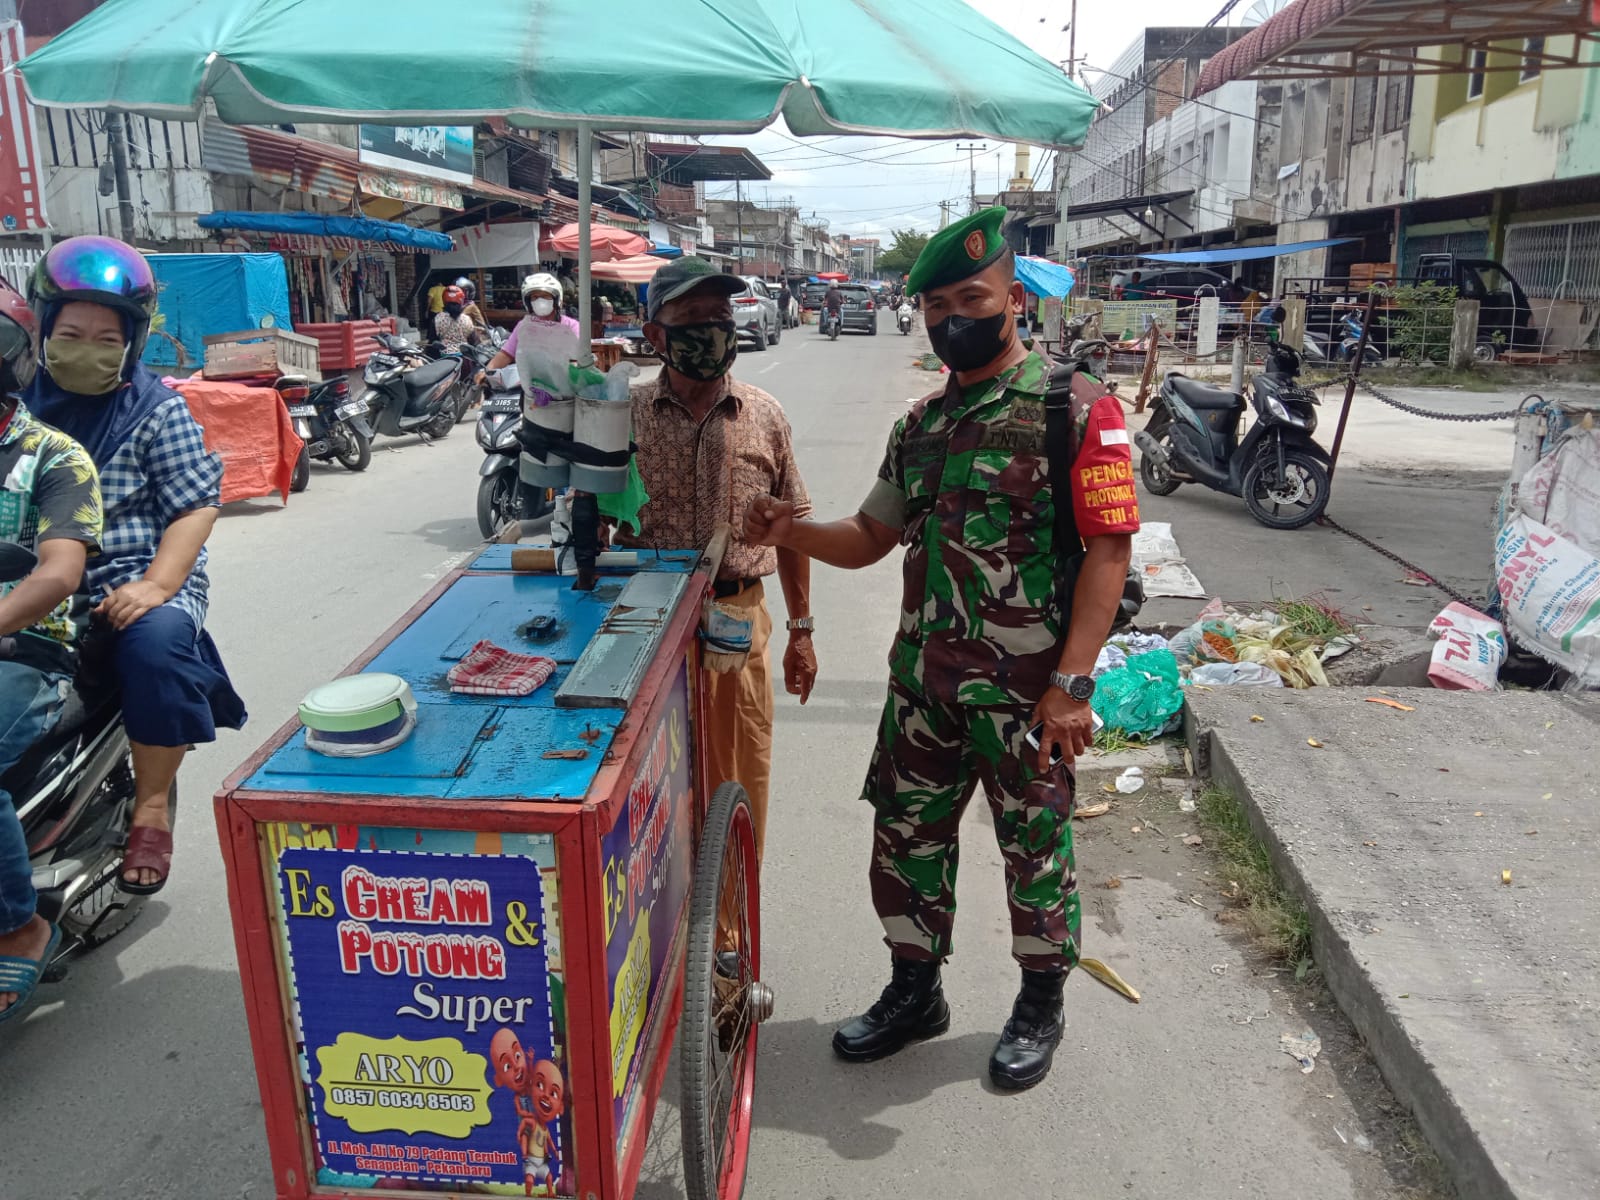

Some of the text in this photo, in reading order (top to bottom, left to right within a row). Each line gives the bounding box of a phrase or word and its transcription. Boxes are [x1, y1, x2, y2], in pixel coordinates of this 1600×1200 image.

[990, 430, 1018, 449] TNI
[1084, 484, 1133, 508] PROTOKOL
[1498, 536, 1526, 567] RESIN
[628, 717, 667, 847] CREAM
[670, 707, 681, 774] &
[628, 774, 671, 926] POTONG
[284, 865, 539, 946] Es CREAM &
[337, 920, 507, 980] POTONG
[396, 983, 534, 1033] Super
[355, 1053, 453, 1085] ARYO
[332, 1088, 475, 1112] 0857 6034 8503
[341, 1142, 370, 1156] Moh.
[371, 1144, 386, 1157] Ali
[389, 1146, 404, 1159] No
[405, 1146, 419, 1159] 79
[422, 1148, 466, 1163] Padang
[468, 1150, 517, 1165] Terubuk
[356, 1157, 419, 1173] Senapelan
[427, 1163, 491, 1177] Pekanbaru
